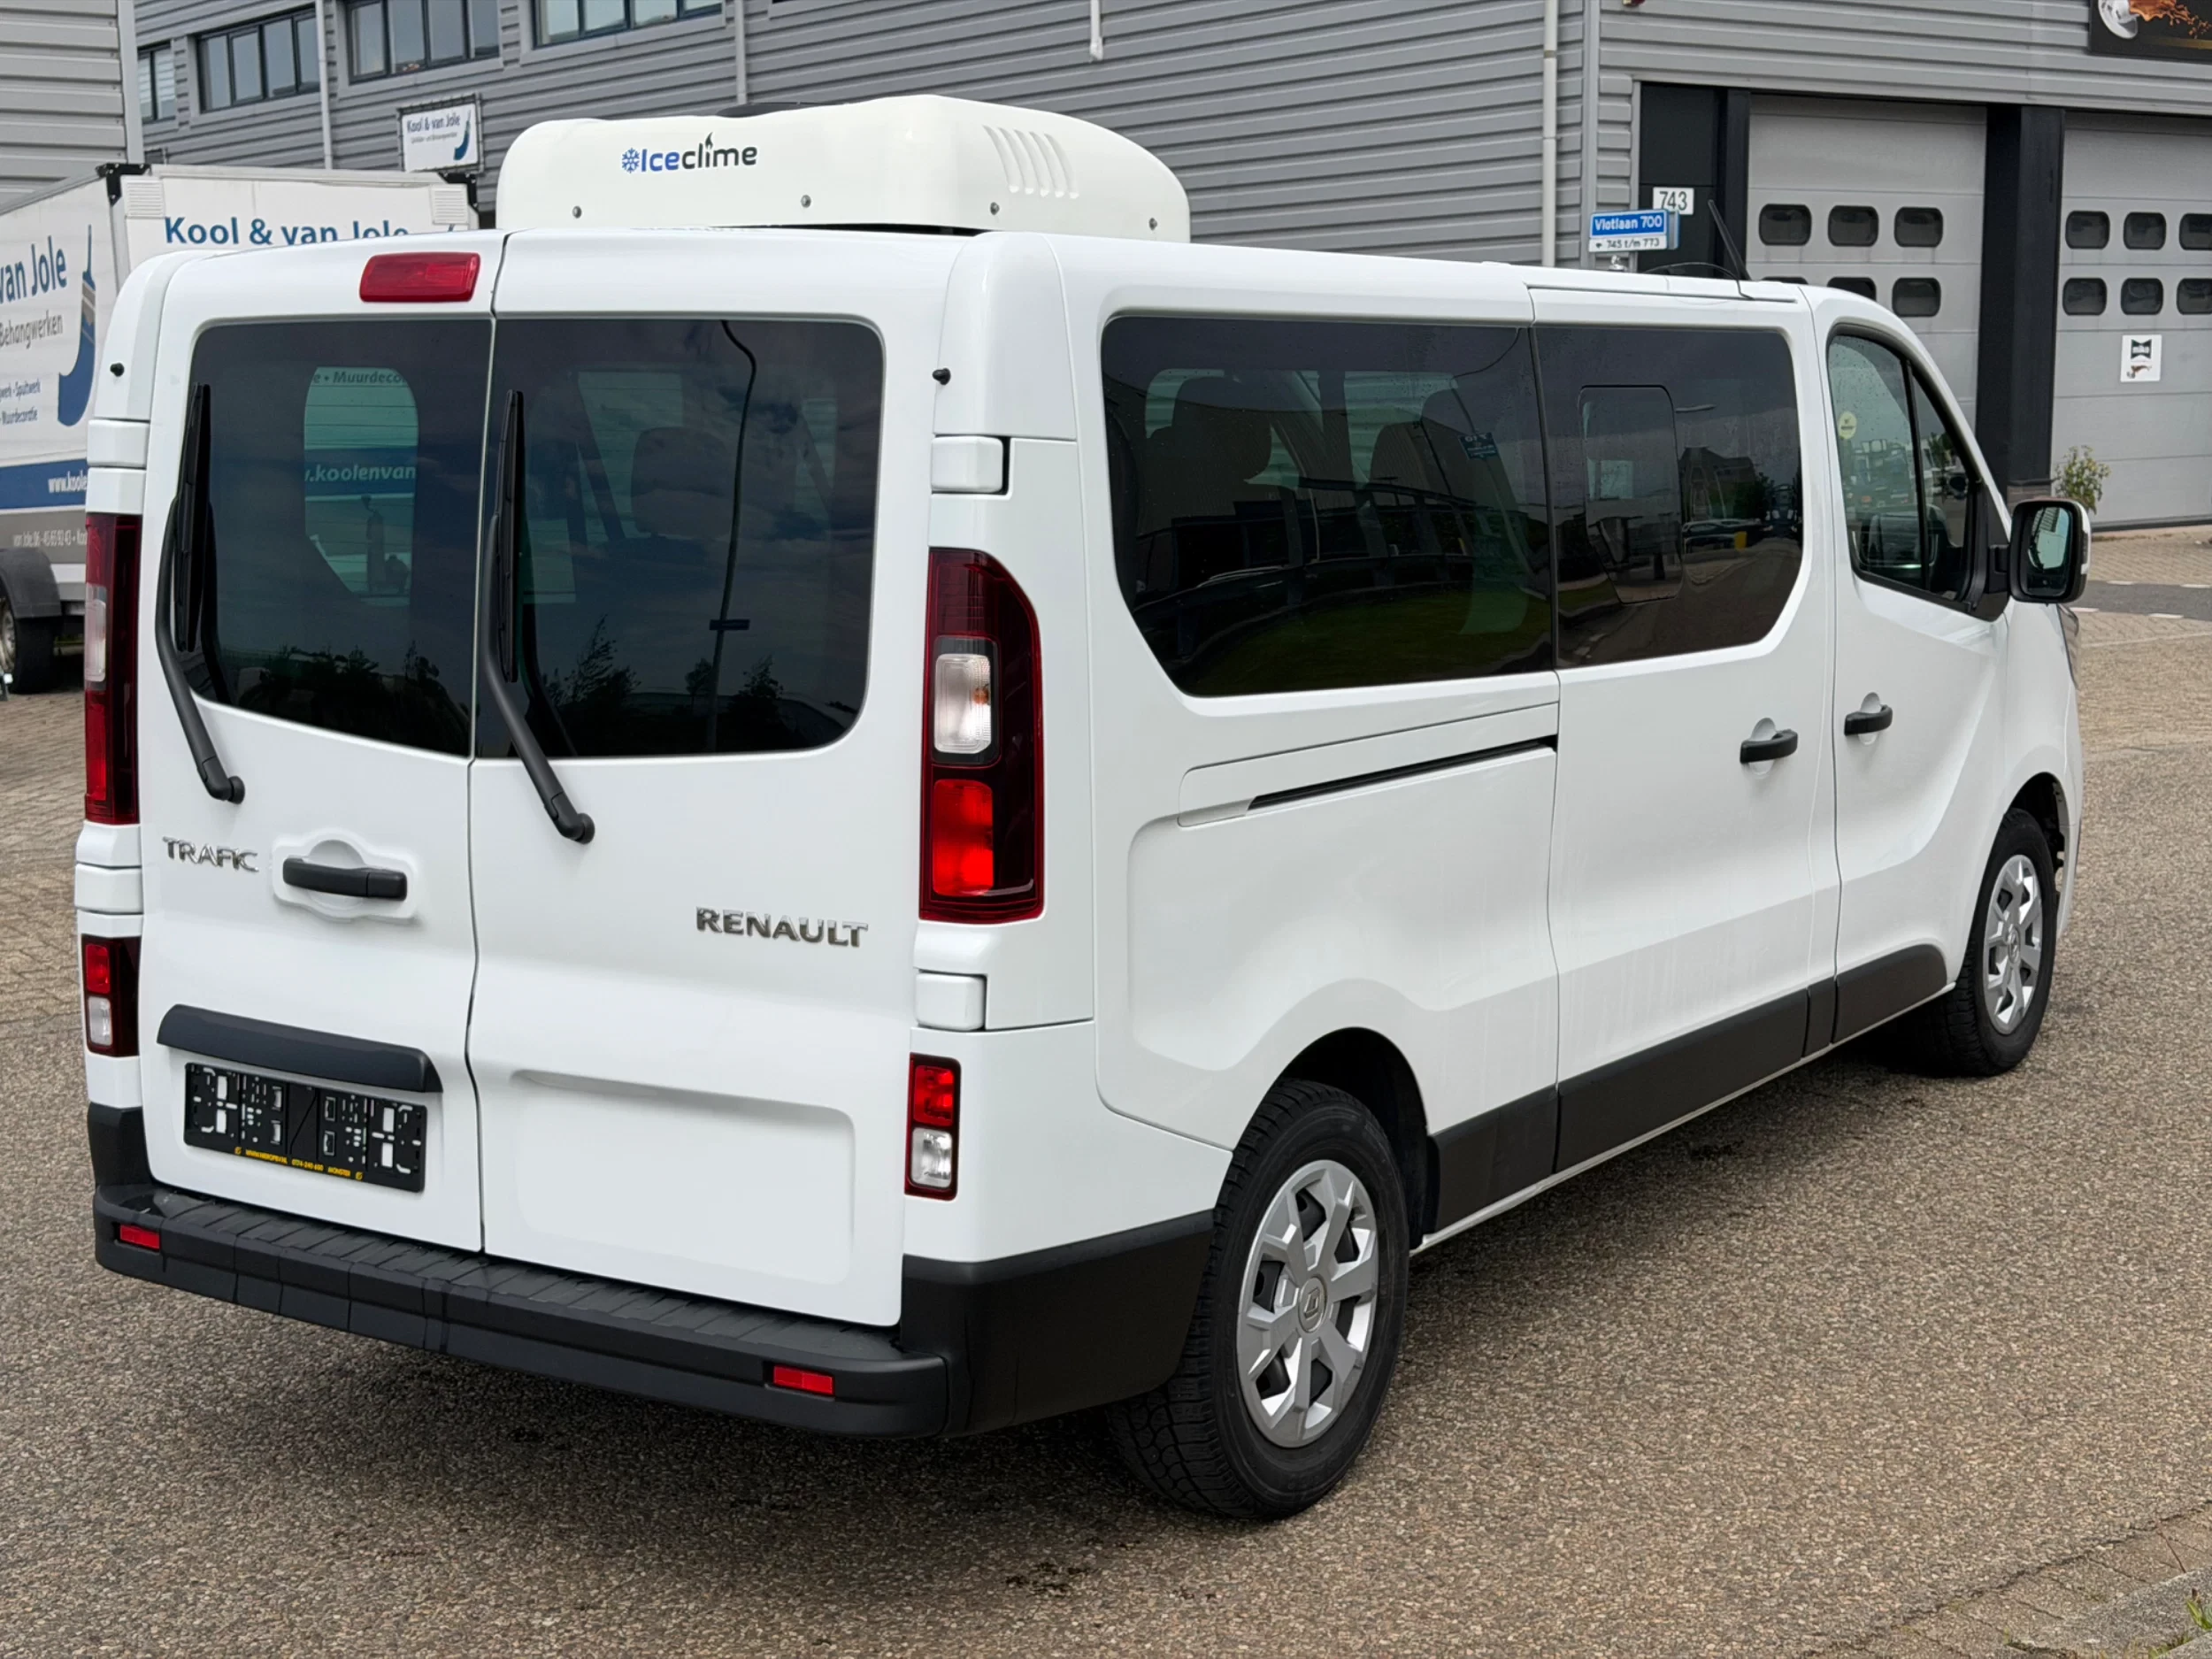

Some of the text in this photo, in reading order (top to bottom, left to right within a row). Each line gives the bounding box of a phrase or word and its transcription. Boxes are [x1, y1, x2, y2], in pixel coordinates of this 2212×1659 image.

[641, 133, 757, 173] Iceclime
[1659, 190, 1687, 211] 743
[165, 217, 240, 245] Kool
[249, 219, 273, 245] &
[280, 225, 339, 245] van
[1594, 215, 1663, 231] Vlotlaan 700
[31, 234, 67, 296] Jole
[162, 836, 260, 872] TRAFIC
[695, 906, 869, 948] RENAULT
